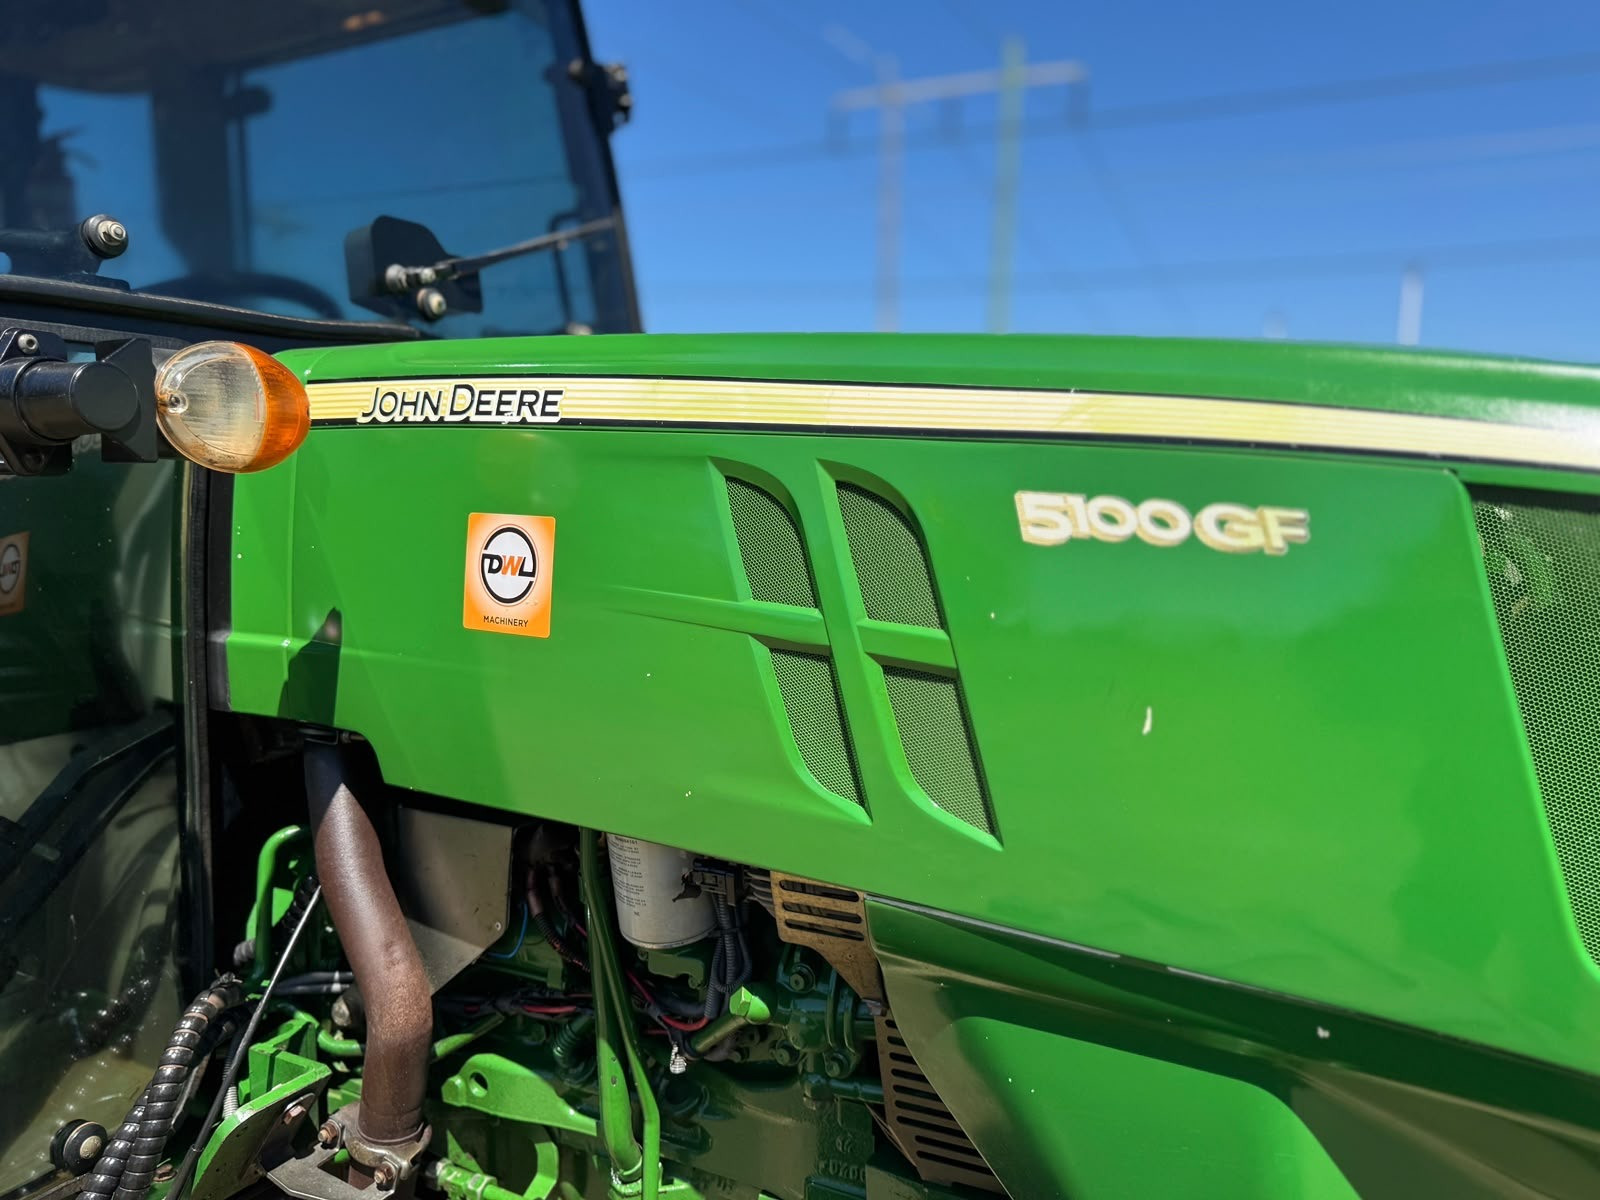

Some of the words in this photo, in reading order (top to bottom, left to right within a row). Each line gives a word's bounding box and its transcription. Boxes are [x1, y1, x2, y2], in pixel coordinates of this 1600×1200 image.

[360, 386, 443, 418] JOHN
[449, 383, 564, 418] DEERE
[481, 552, 536, 578] DWL
[483, 615, 529, 628] MACHINERY
